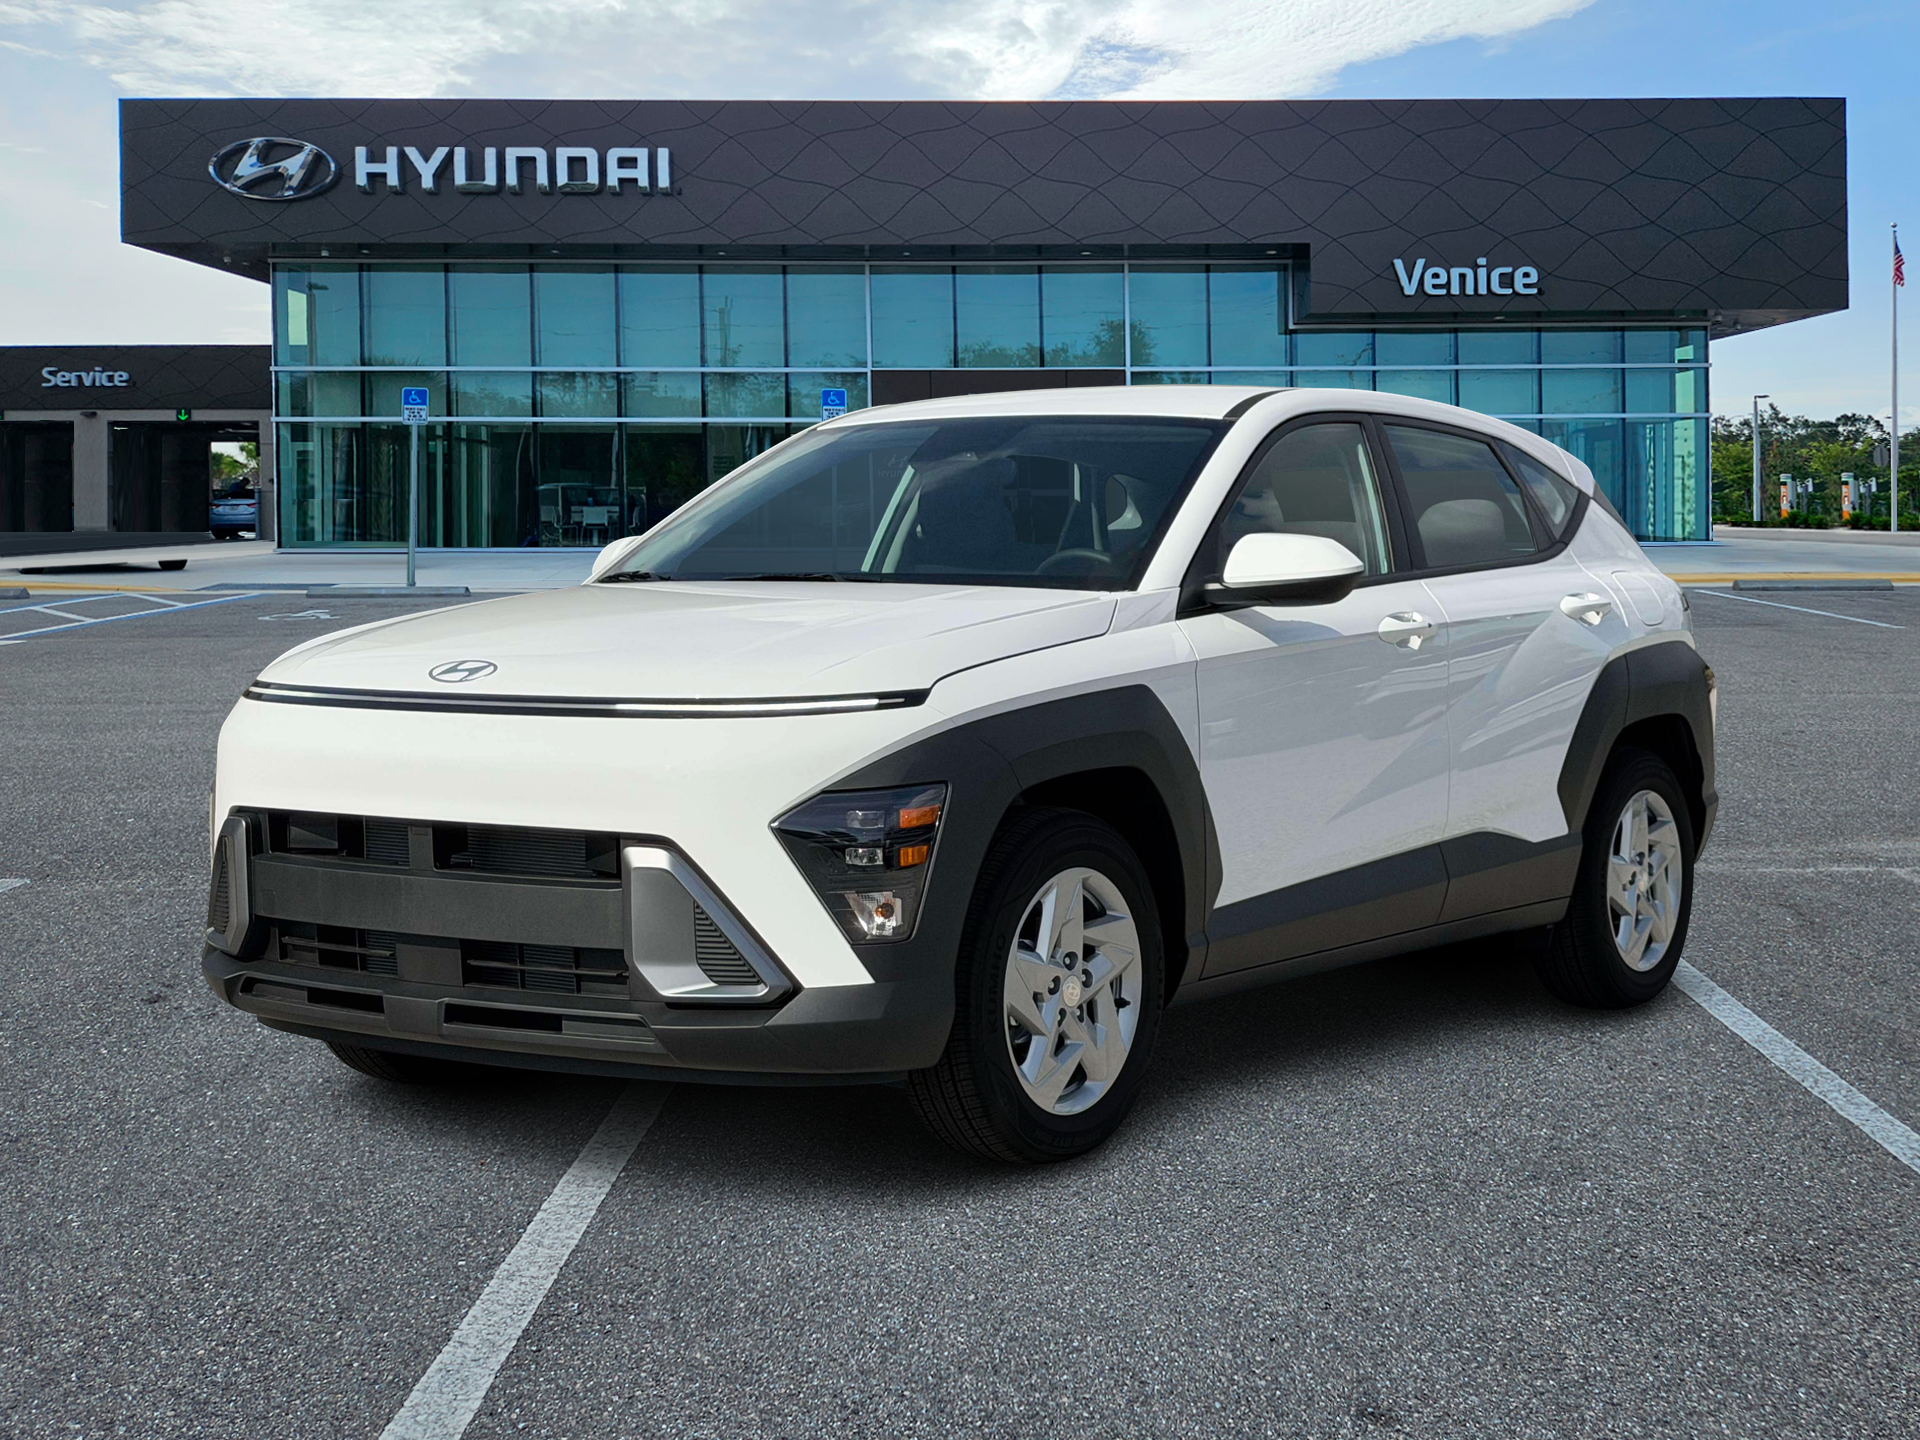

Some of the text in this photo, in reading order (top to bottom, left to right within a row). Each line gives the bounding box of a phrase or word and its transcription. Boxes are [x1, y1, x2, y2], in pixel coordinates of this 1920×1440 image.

[354, 146, 672, 193] HYUNDAI
[1392, 257, 1539, 296] Venice
[41, 366, 130, 387] Service
